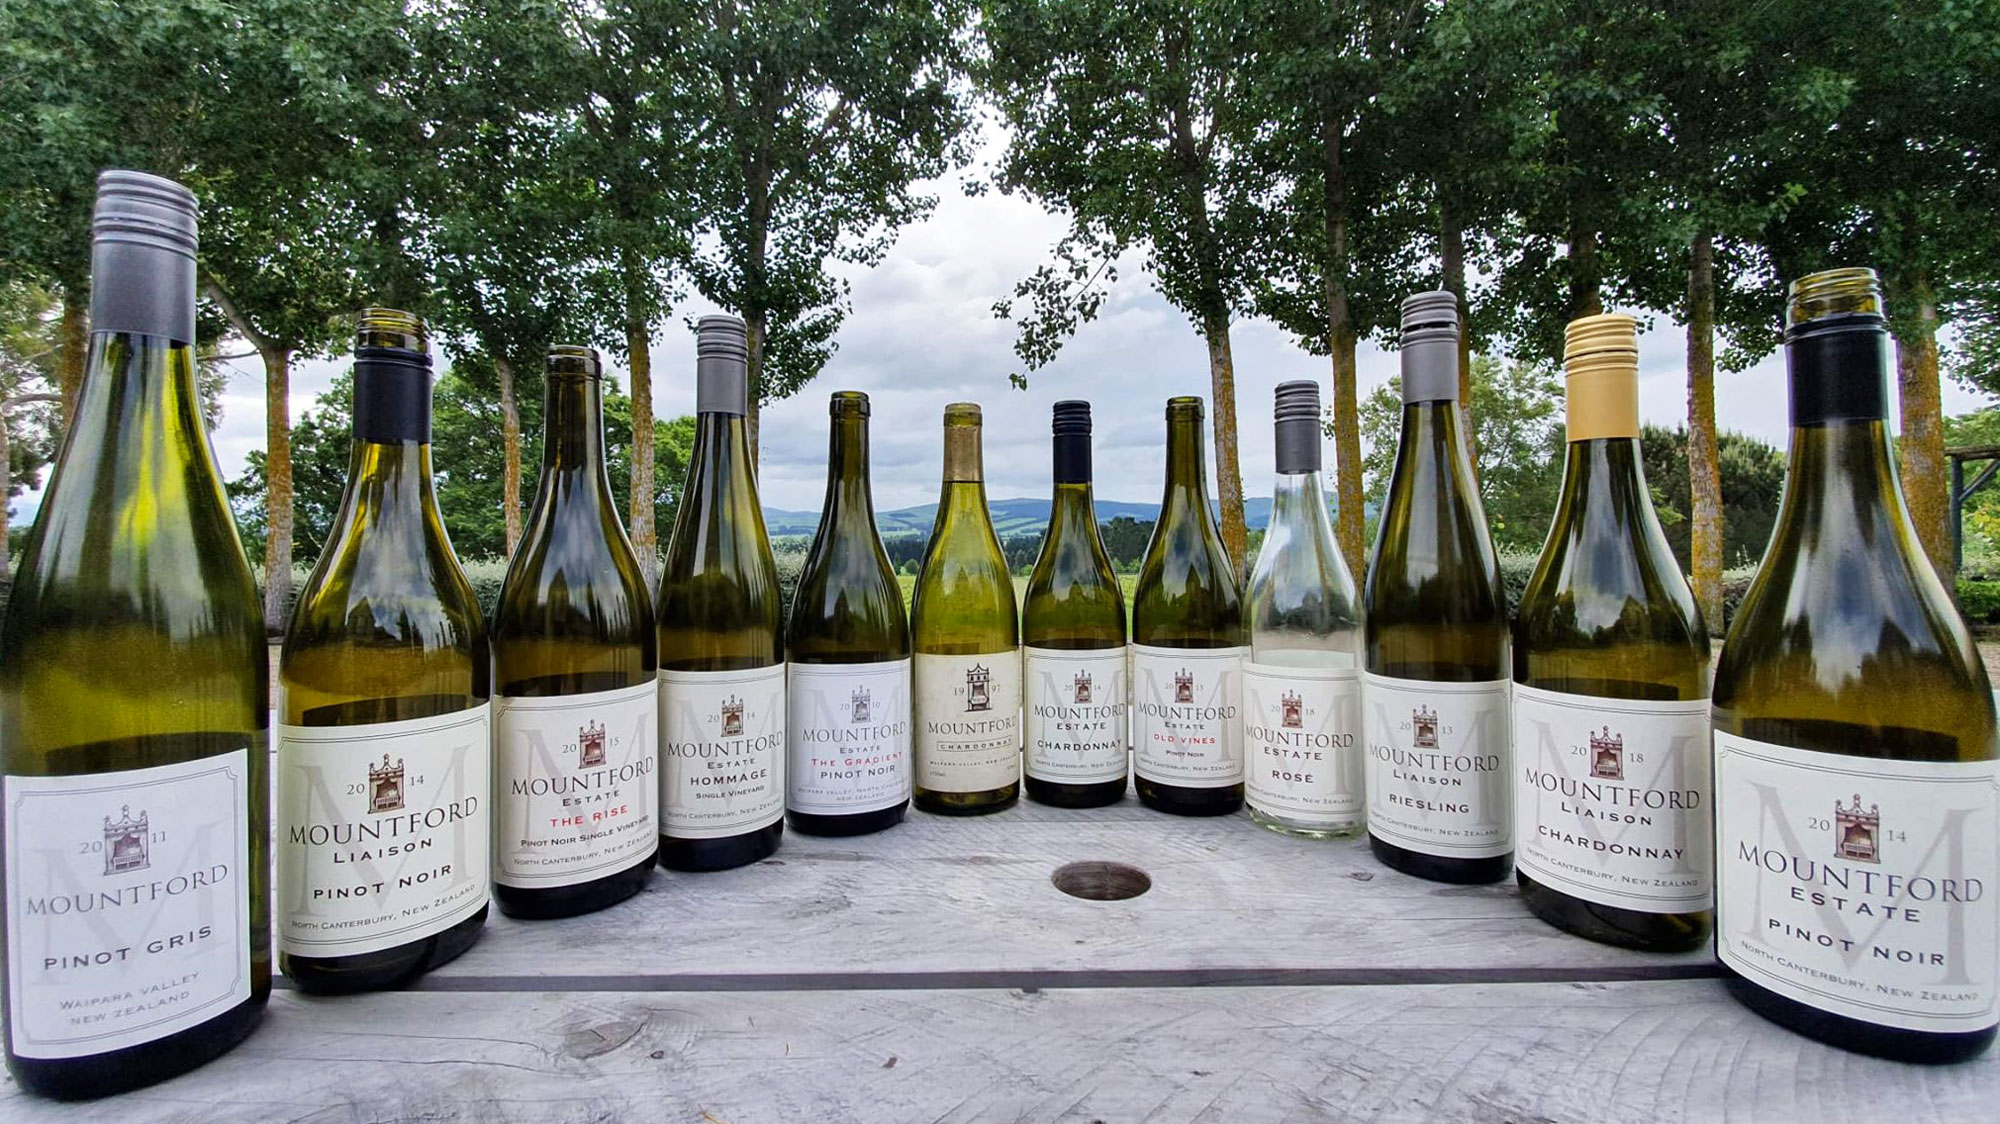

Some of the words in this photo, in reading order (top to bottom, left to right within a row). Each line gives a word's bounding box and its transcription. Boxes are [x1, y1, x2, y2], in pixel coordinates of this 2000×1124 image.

[954, 687, 965, 696] 19
[707, 715, 720, 723] 20
[1034, 703, 1125, 720] MOUNTFORD
[1139, 701, 1236, 721] MOUNTFORD
[802, 721, 906, 743] MOUNTFORD
[1057, 722, 1107, 730] ESTATE
[1164, 721, 1204, 730] ESTATE
[667, 731, 783, 759] MOUNTFORD
[940, 738, 1012, 749] CHARDONNAY
[1037, 739, 1121, 751] CHARDONNAY
[1154, 733, 1175, 743] OLD
[1246, 724, 1354, 749] MOUNTFORD
[562, 744, 577, 754] 20
[840, 745, 882, 755] ESTATE
[1264, 746, 1323, 760] ESTATE
[1369, 742, 1499, 772] MOUNTFORD
[1571, 745, 1587, 756] 20
[1629, 752, 1644, 763] 18
[707, 758, 756, 769] ESTATE
[812, 758, 836, 768] THE
[844, 752, 902, 767] GRADIENT
[511, 756, 654, 796] MOUNTFORD
[691, 769, 767, 786] HOMMAGE
[820, 770, 862, 779] PINOT
[868, 765, 896, 776] NOIR
[1393, 769, 1462, 786] LIAISON
[347, 784, 365, 795] 20
[409, 775, 424, 786] 14
[696, 790, 725, 799] SINGLE
[728, 785, 765, 797] VINEYARD
[1525, 767, 1700, 810] MOUNTFORD
[562, 790, 621, 807] ESTATE
[1389, 793, 1470, 813] RIESLING
[289, 796, 478, 846] MOUNTFORD
[550, 816, 583, 828] THE
[593, 805, 628, 821] RISE
[1561, 801, 1652, 826] LIAISON
[551, 837, 576, 846] NOIR
[579, 829, 613, 842] SINGLE
[616, 815, 649, 832] VINEYARD
[1440, 828, 1460, 836] NEW
[1808, 816, 1830, 831] 20
[1887, 829, 1907, 843] 14
[80, 842, 102, 855] 20
[334, 838, 432, 864] LIAISON
[604, 844, 624, 854] NEW
[1538, 825, 1684, 860] CHARDONNAY
[1551, 858, 1617, 882] CANTERBURY,
[1622, 876, 1649, 886] NEW
[1654, 879, 1698, 888] ZEALAND
[1738, 840, 1984, 903] MOUNTFORD
[27, 864, 228, 916] MOUNTFORD
[314, 883, 384, 900] PINOT
[399, 864, 452, 889] NOIR
[321, 914, 397, 930] CANTERBURY,
[402, 904, 429, 917] NEW
[434, 884, 476, 908] ZEALAND
[1791, 886, 1921, 923] ESTATE
[44, 948, 131, 970] PINOT
[147, 926, 212, 955] GRIS
[1768, 918, 1855, 952] PINOT
[1873, 946, 1945, 966] NOIR
[1741, 940, 1774, 961] NORTH
[1777, 957, 1869, 991] CANTERBURY,
[1876, 984, 1915, 1000] NEW
[1921, 990, 1980, 1001] ZEALAND
[60, 992, 133, 1011] WAIPARA
[140, 972, 200, 994] VALLEY
[70, 1013, 106, 1026] NEW
[114, 991, 190, 1018] ZEALAND
